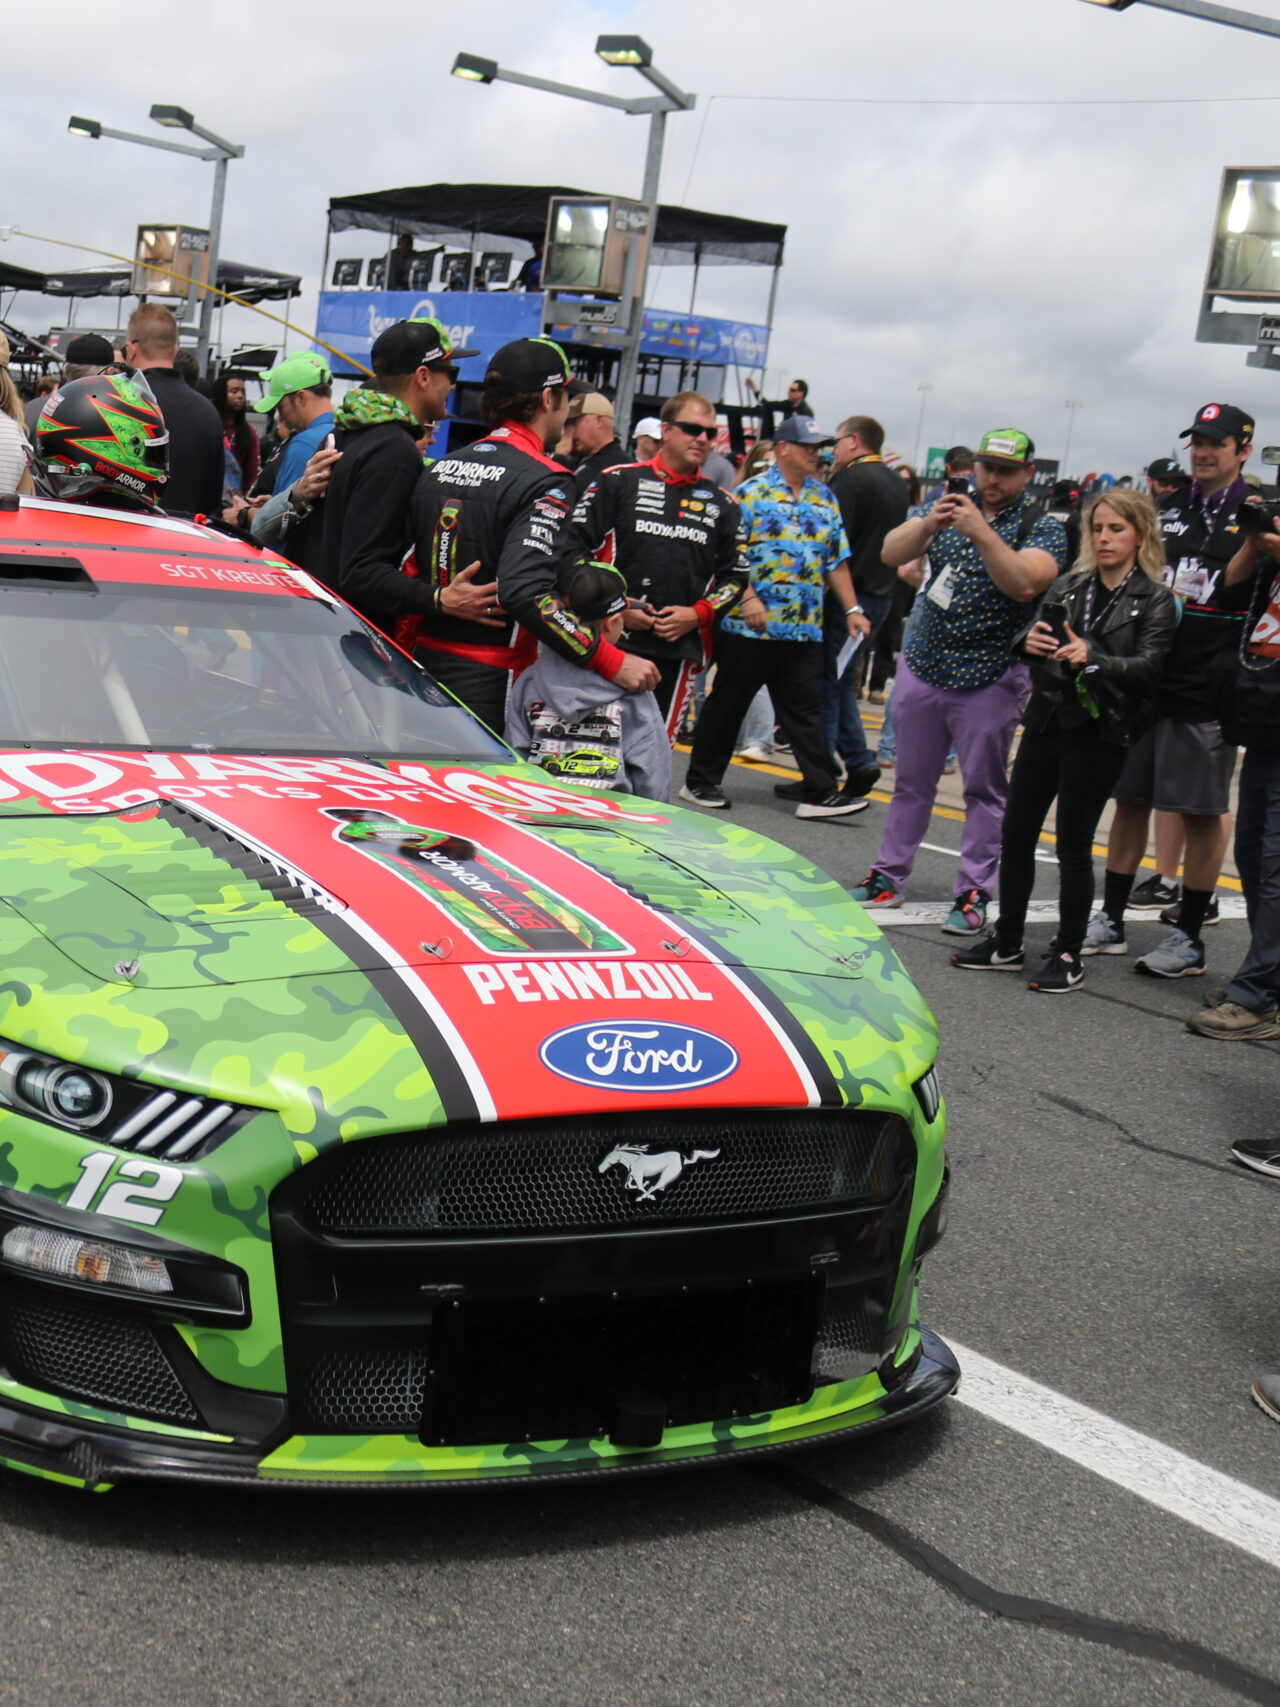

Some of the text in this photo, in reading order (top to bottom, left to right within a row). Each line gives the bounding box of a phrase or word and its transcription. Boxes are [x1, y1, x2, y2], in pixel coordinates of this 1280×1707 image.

[431, 459, 506, 482] BODYARMOR
[437, 472, 464, 486] Sports
[635, 519, 708, 545] BODYARMOR
[160, 563, 208, 579] SGT
[563, 761, 578, 771] 12
[52, 782, 323, 815] Sports
[460, 961, 714, 1006] PENNZOIL
[586, 1029, 704, 1078] Ford
[66, 1150, 184, 1227] 12
